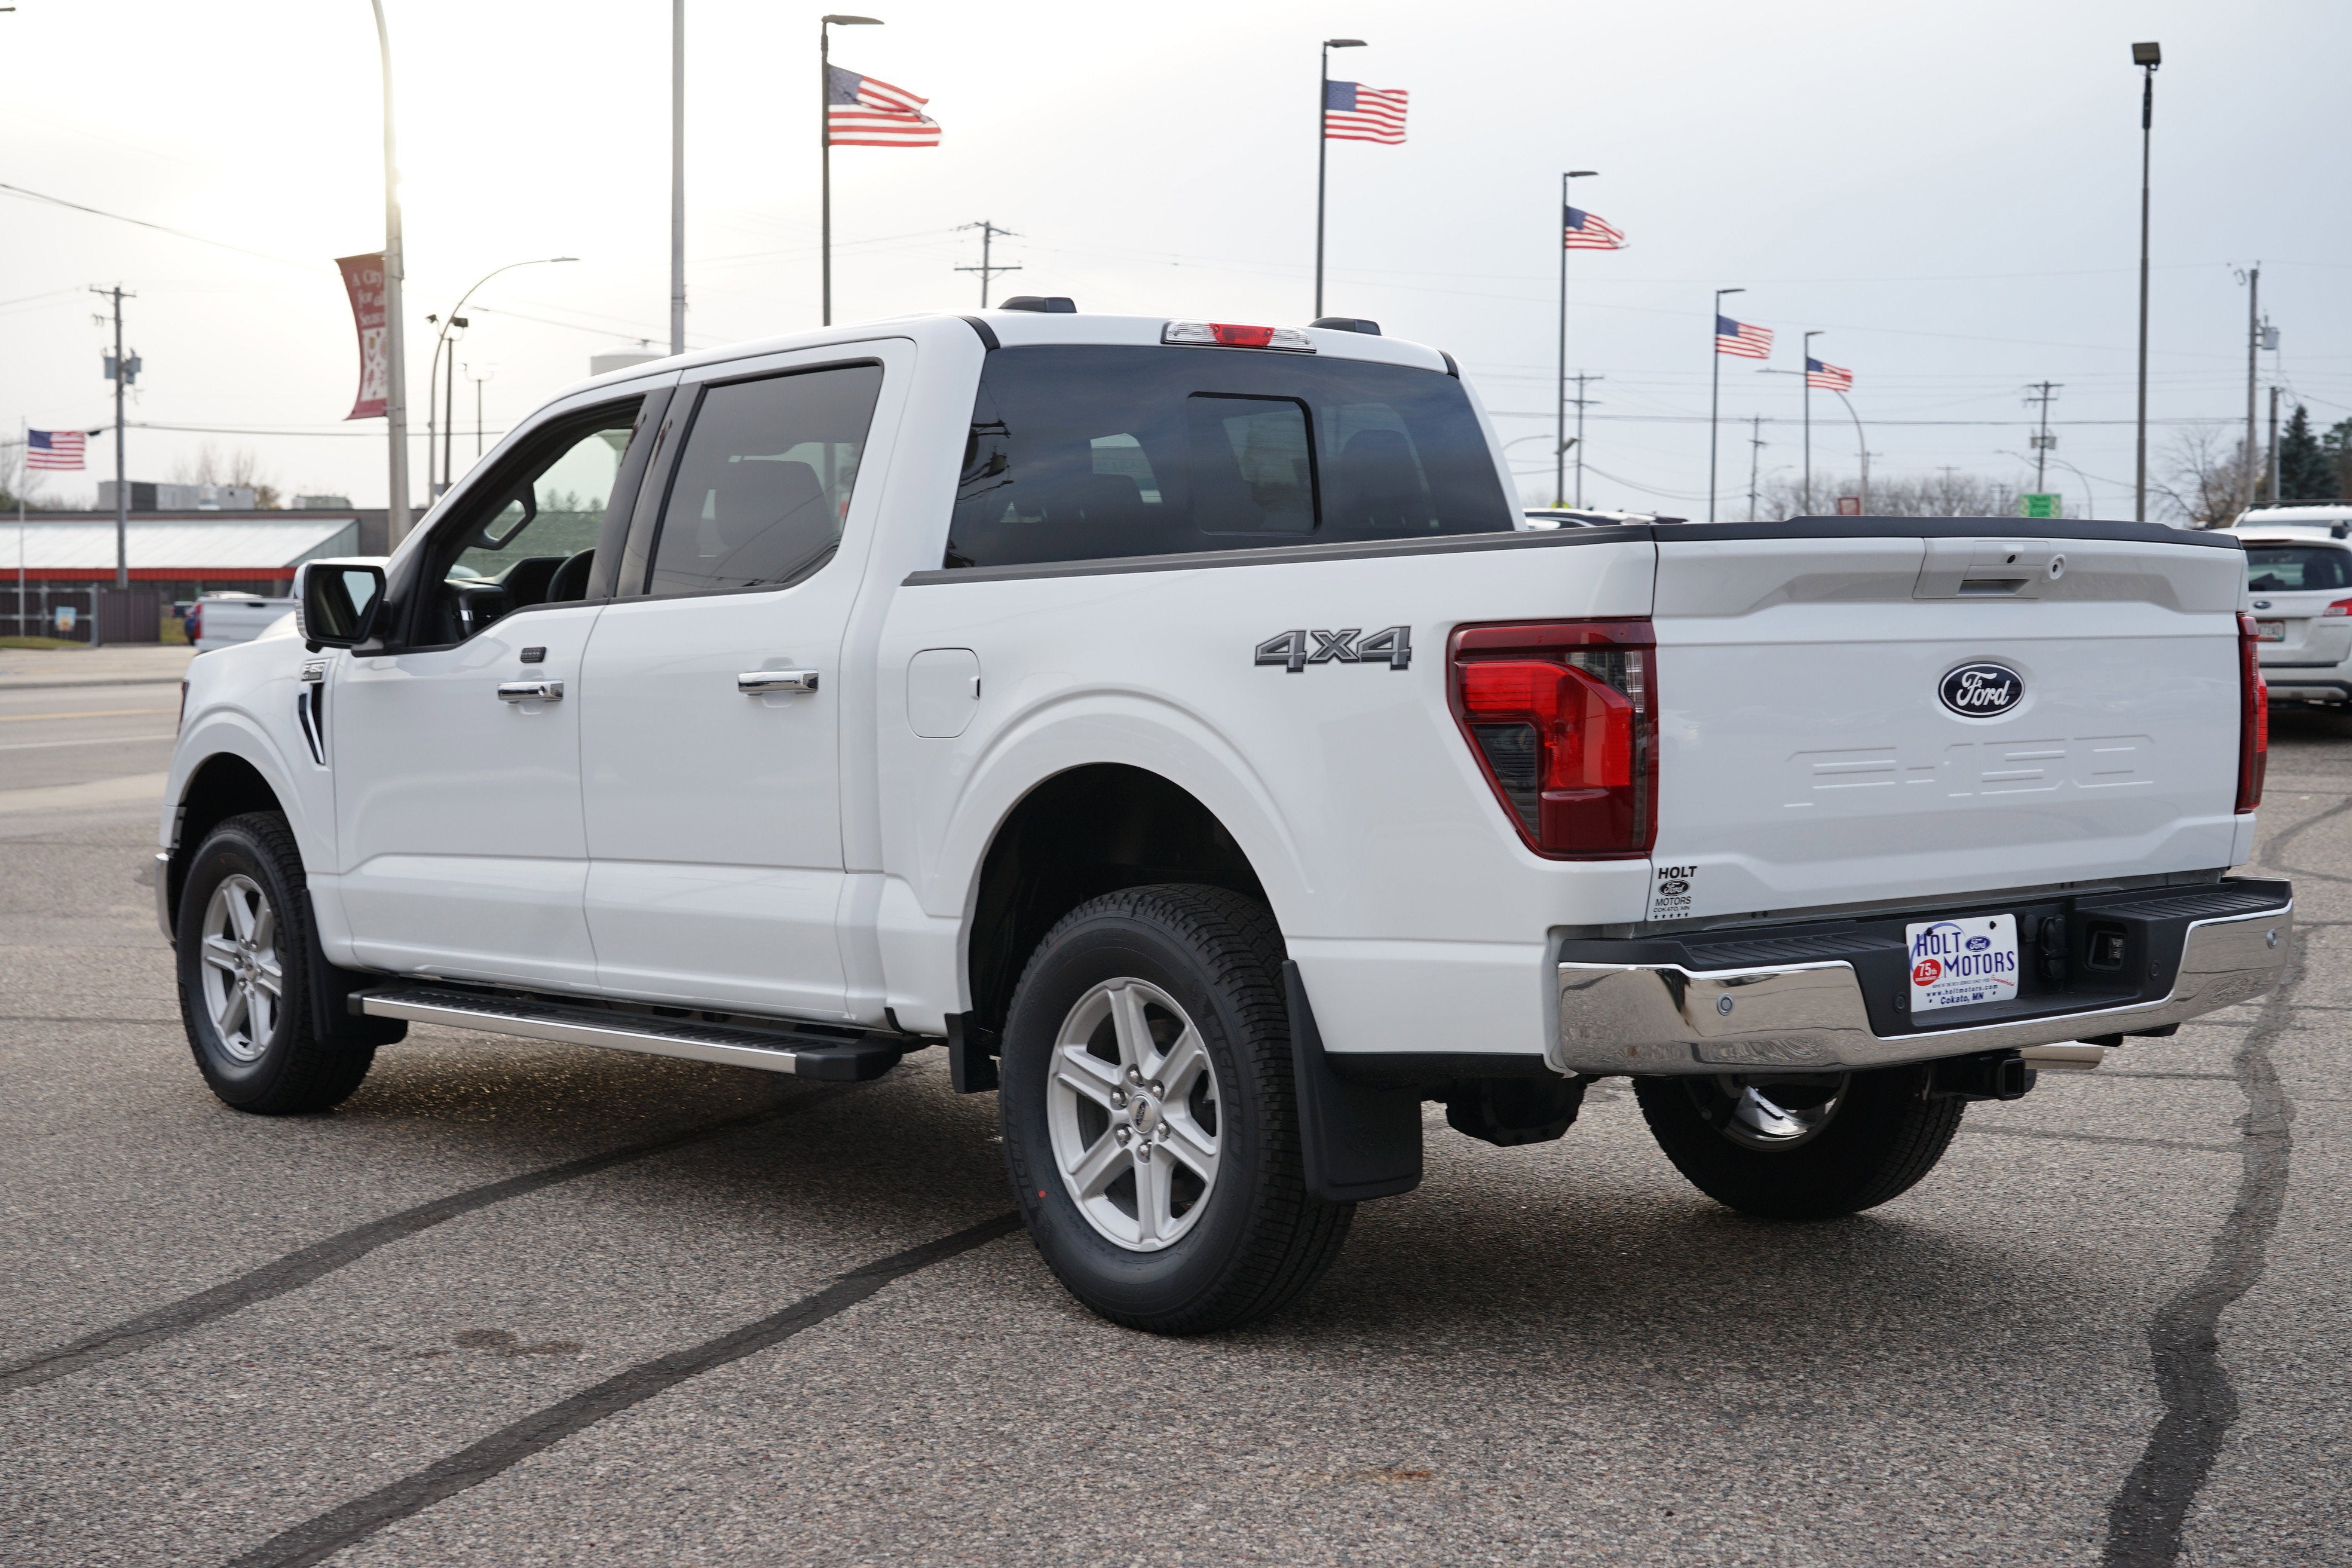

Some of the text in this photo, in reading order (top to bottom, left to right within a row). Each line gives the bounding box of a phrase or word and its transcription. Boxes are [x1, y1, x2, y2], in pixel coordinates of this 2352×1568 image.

[1956, 671, 2011, 706] Ford
[1658, 866, 1698, 879] HOLT
[1664, 881, 1685, 894] Ford
[1655, 896, 1692, 906] MOTORS
[1916, 932, 1987, 957] HOLT Ford
[1944, 951, 2015, 978] MOTORS
[1926, 985, 1998, 997] www.holtmotors.com
[1940, 992, 1984, 1004] Cokato, MN
